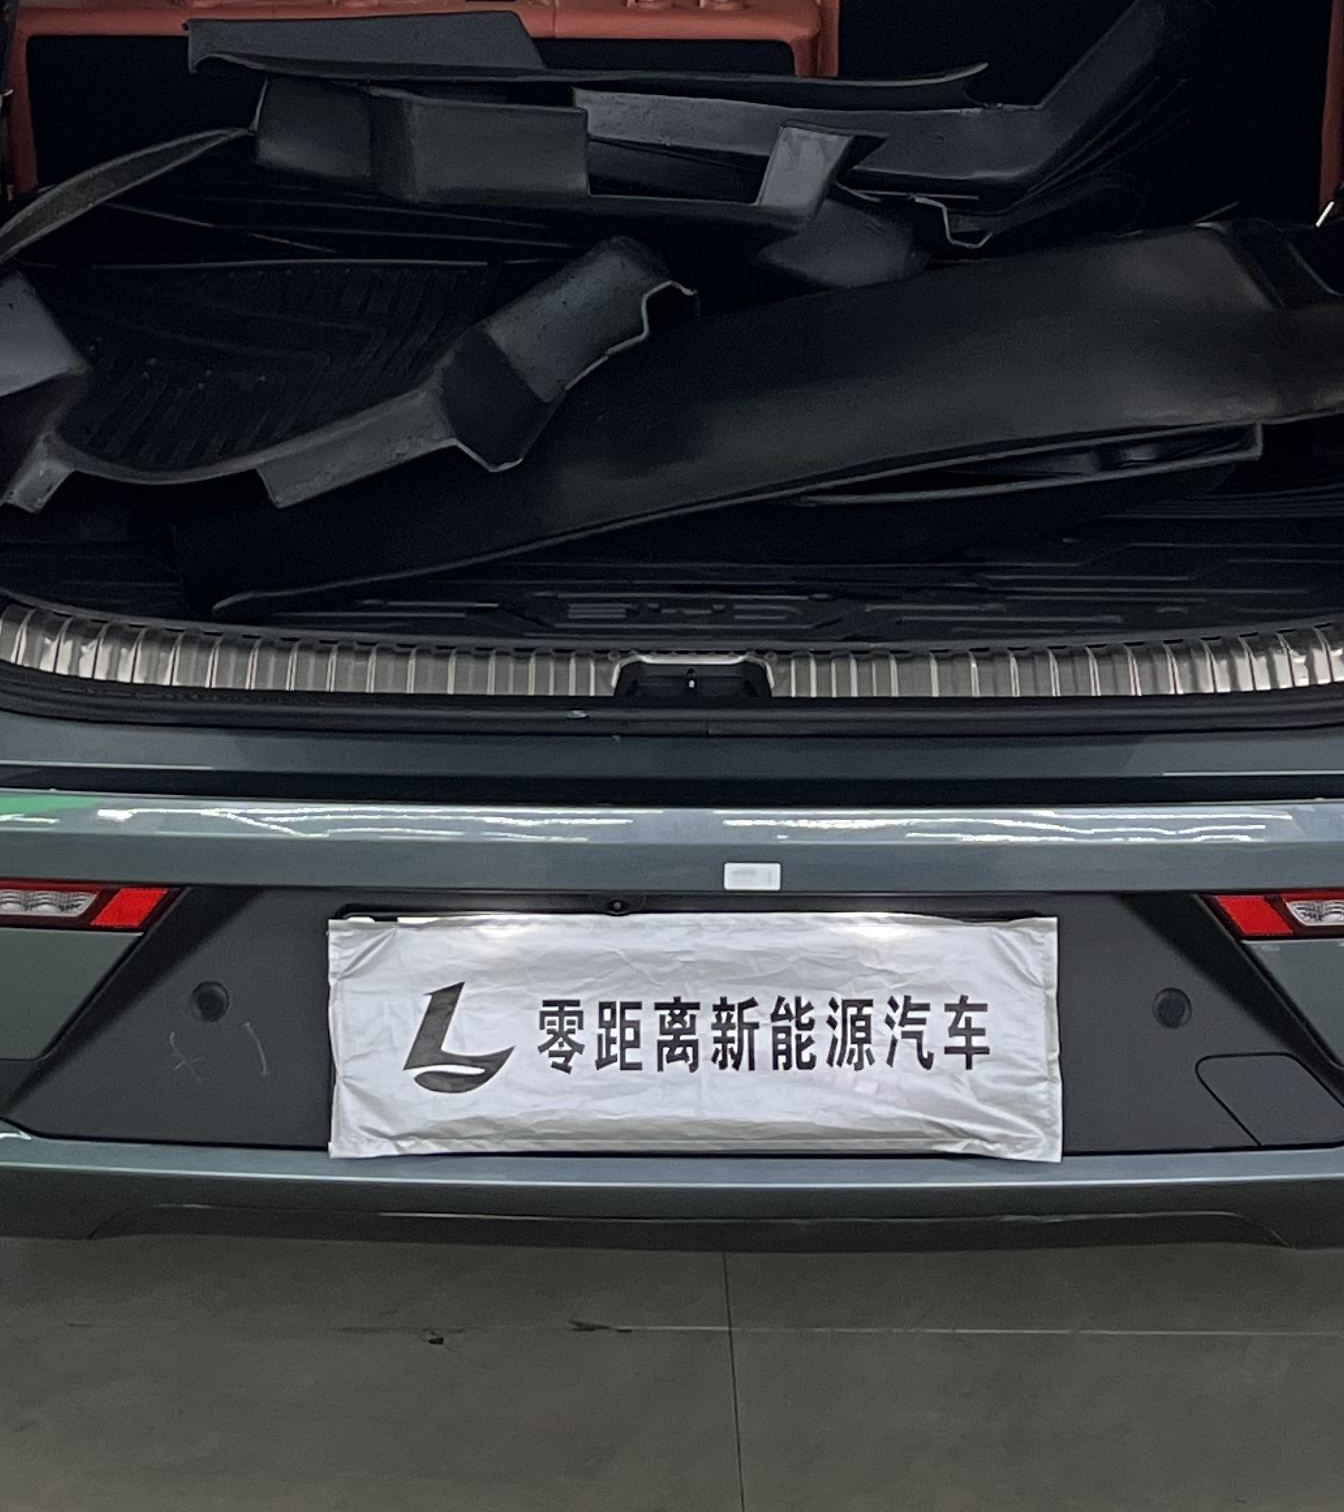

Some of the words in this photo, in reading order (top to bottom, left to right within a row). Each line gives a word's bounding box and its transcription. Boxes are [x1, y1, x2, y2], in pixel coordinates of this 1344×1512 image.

[536, 993, 993, 1075] 零距离新能源汽车
